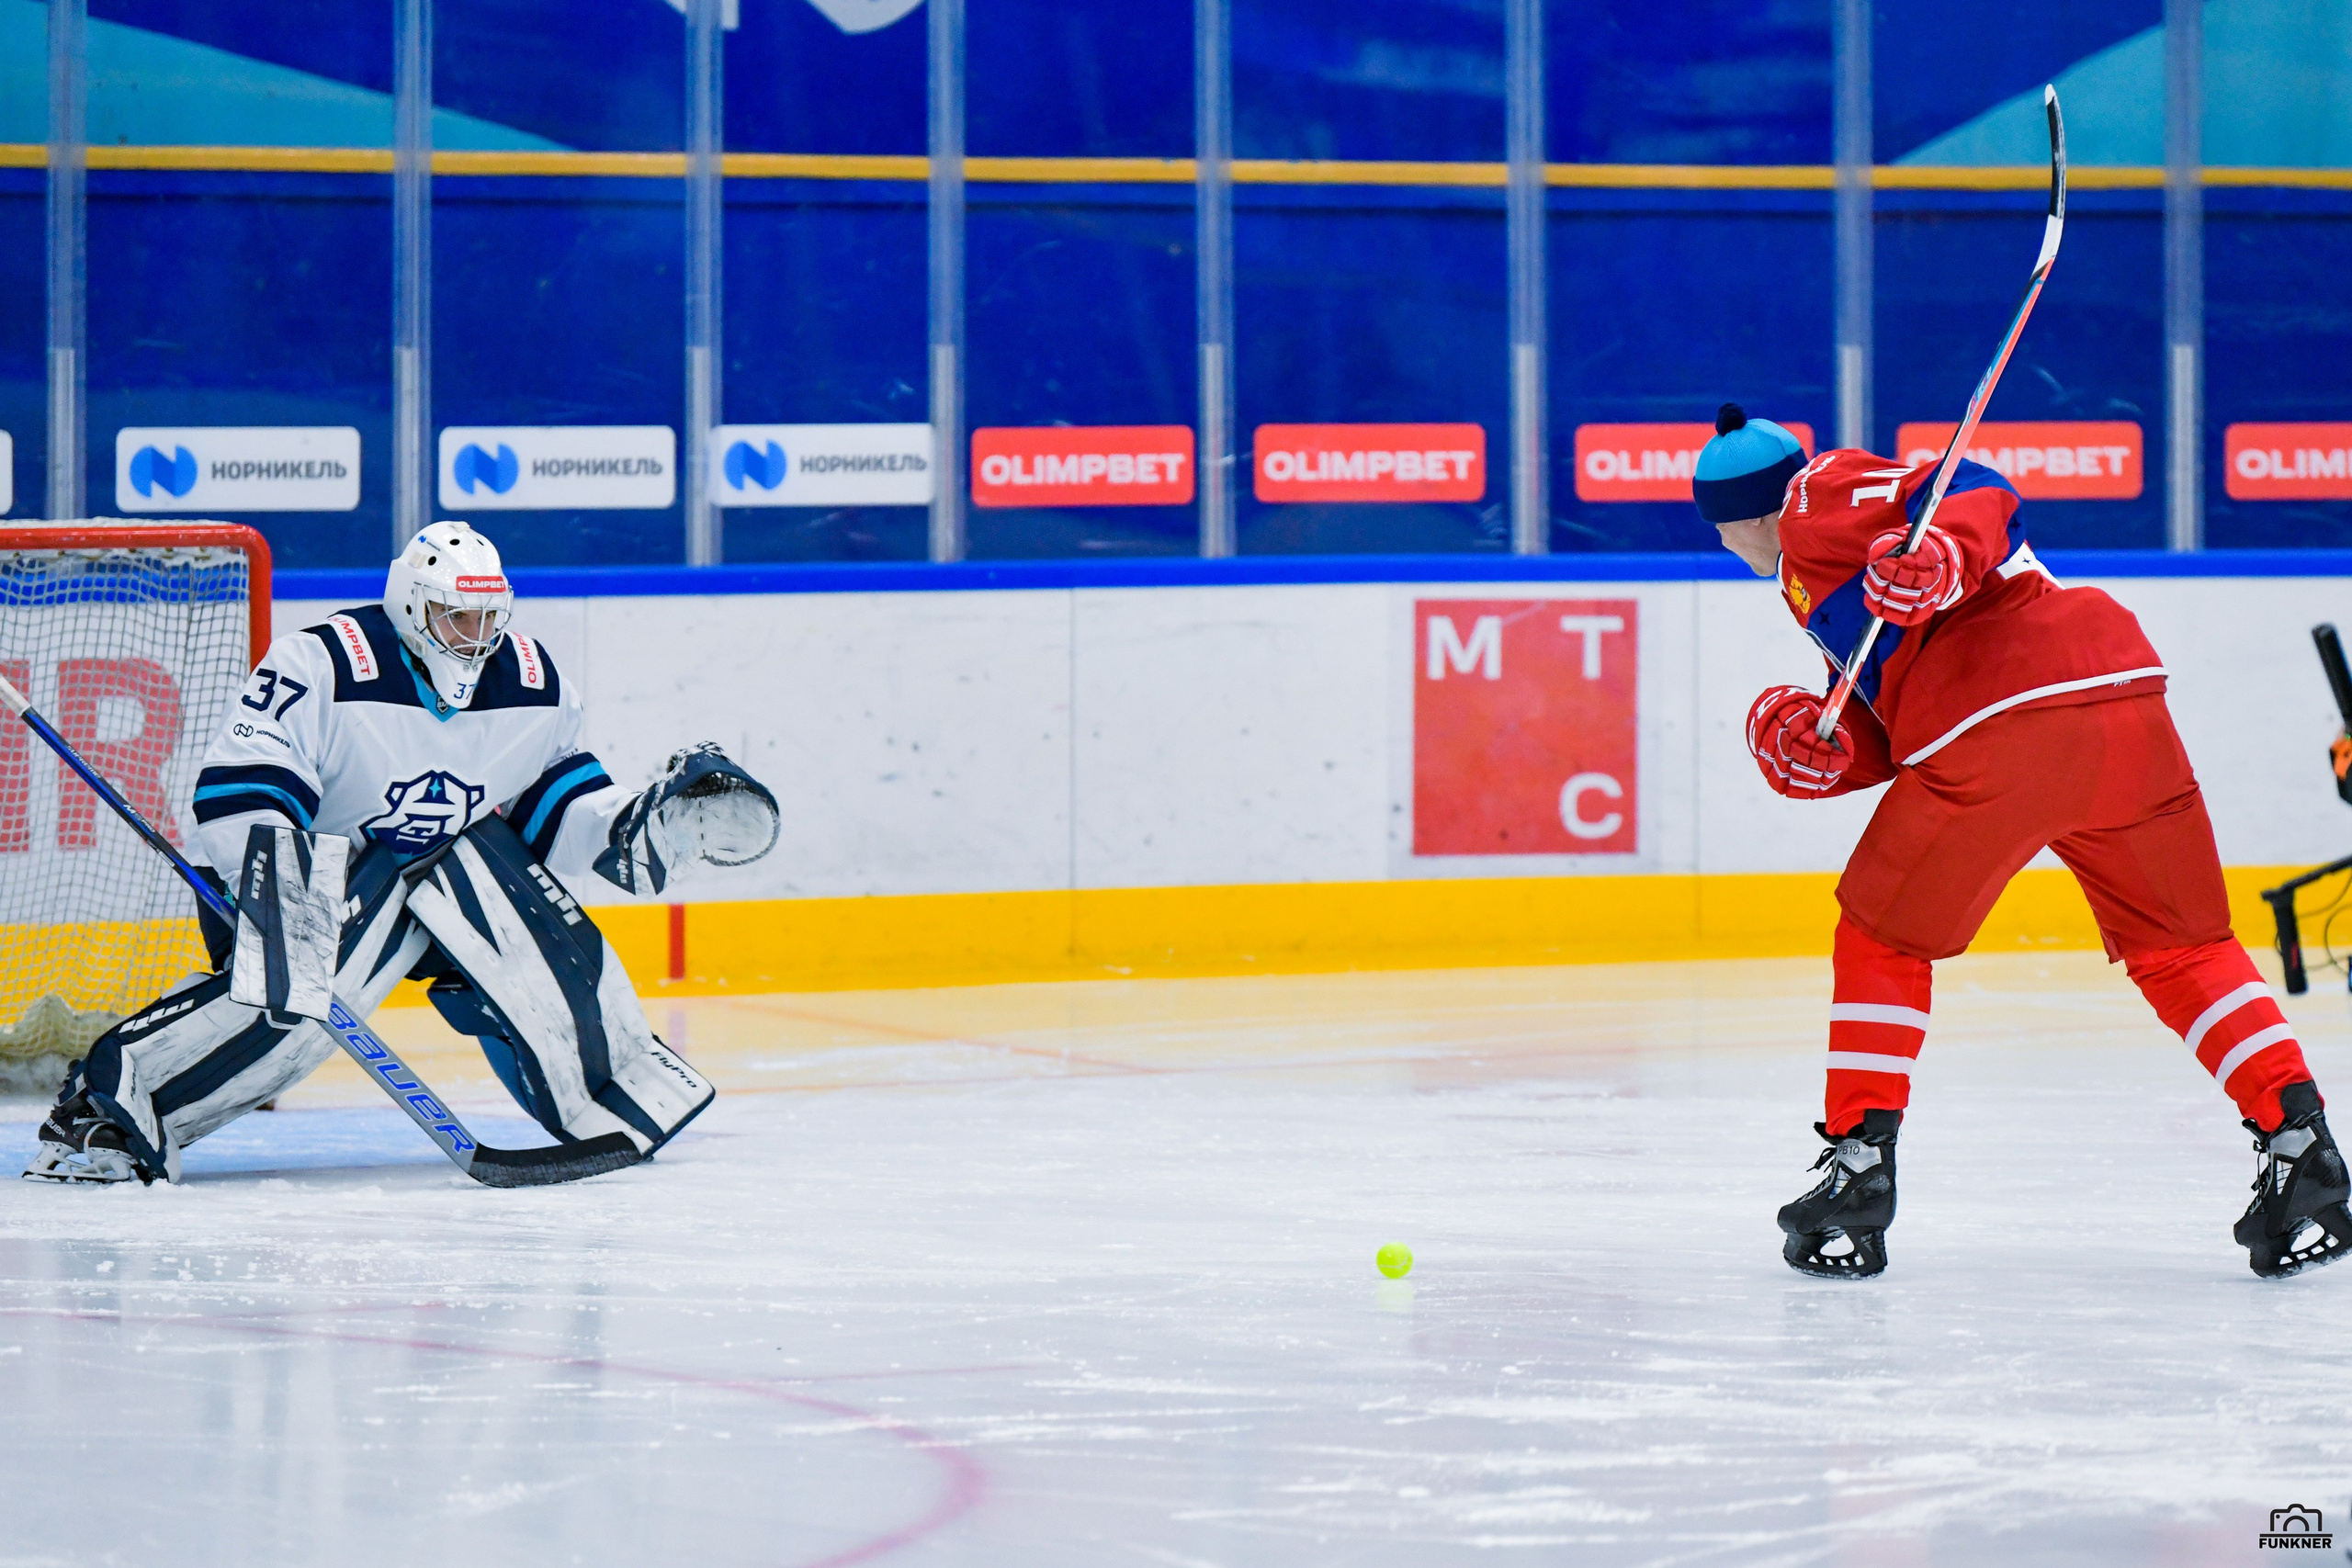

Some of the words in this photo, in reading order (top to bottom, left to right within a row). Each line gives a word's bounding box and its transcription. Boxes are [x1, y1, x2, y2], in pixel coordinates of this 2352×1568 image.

[211, 460, 347, 480] НОРНИКЕЛЬ
[532, 457, 663, 477] НОРНИКЕЛЬ
[799, 454, 927, 473] НОРНИКЕЛЬ
[980, 453, 1185, 486] OLIMPBET
[1262, 450, 1476, 481] OLIMPBET
[1585, 449, 1699, 481] OLIM
[1905, 446, 2131, 478] OMPBET
[2235, 447, 2352, 479] OLIM
[242, 668, 309, 722] 37
[454, 682, 476, 699] 37
[45, 1117, 66, 1137] AUER
